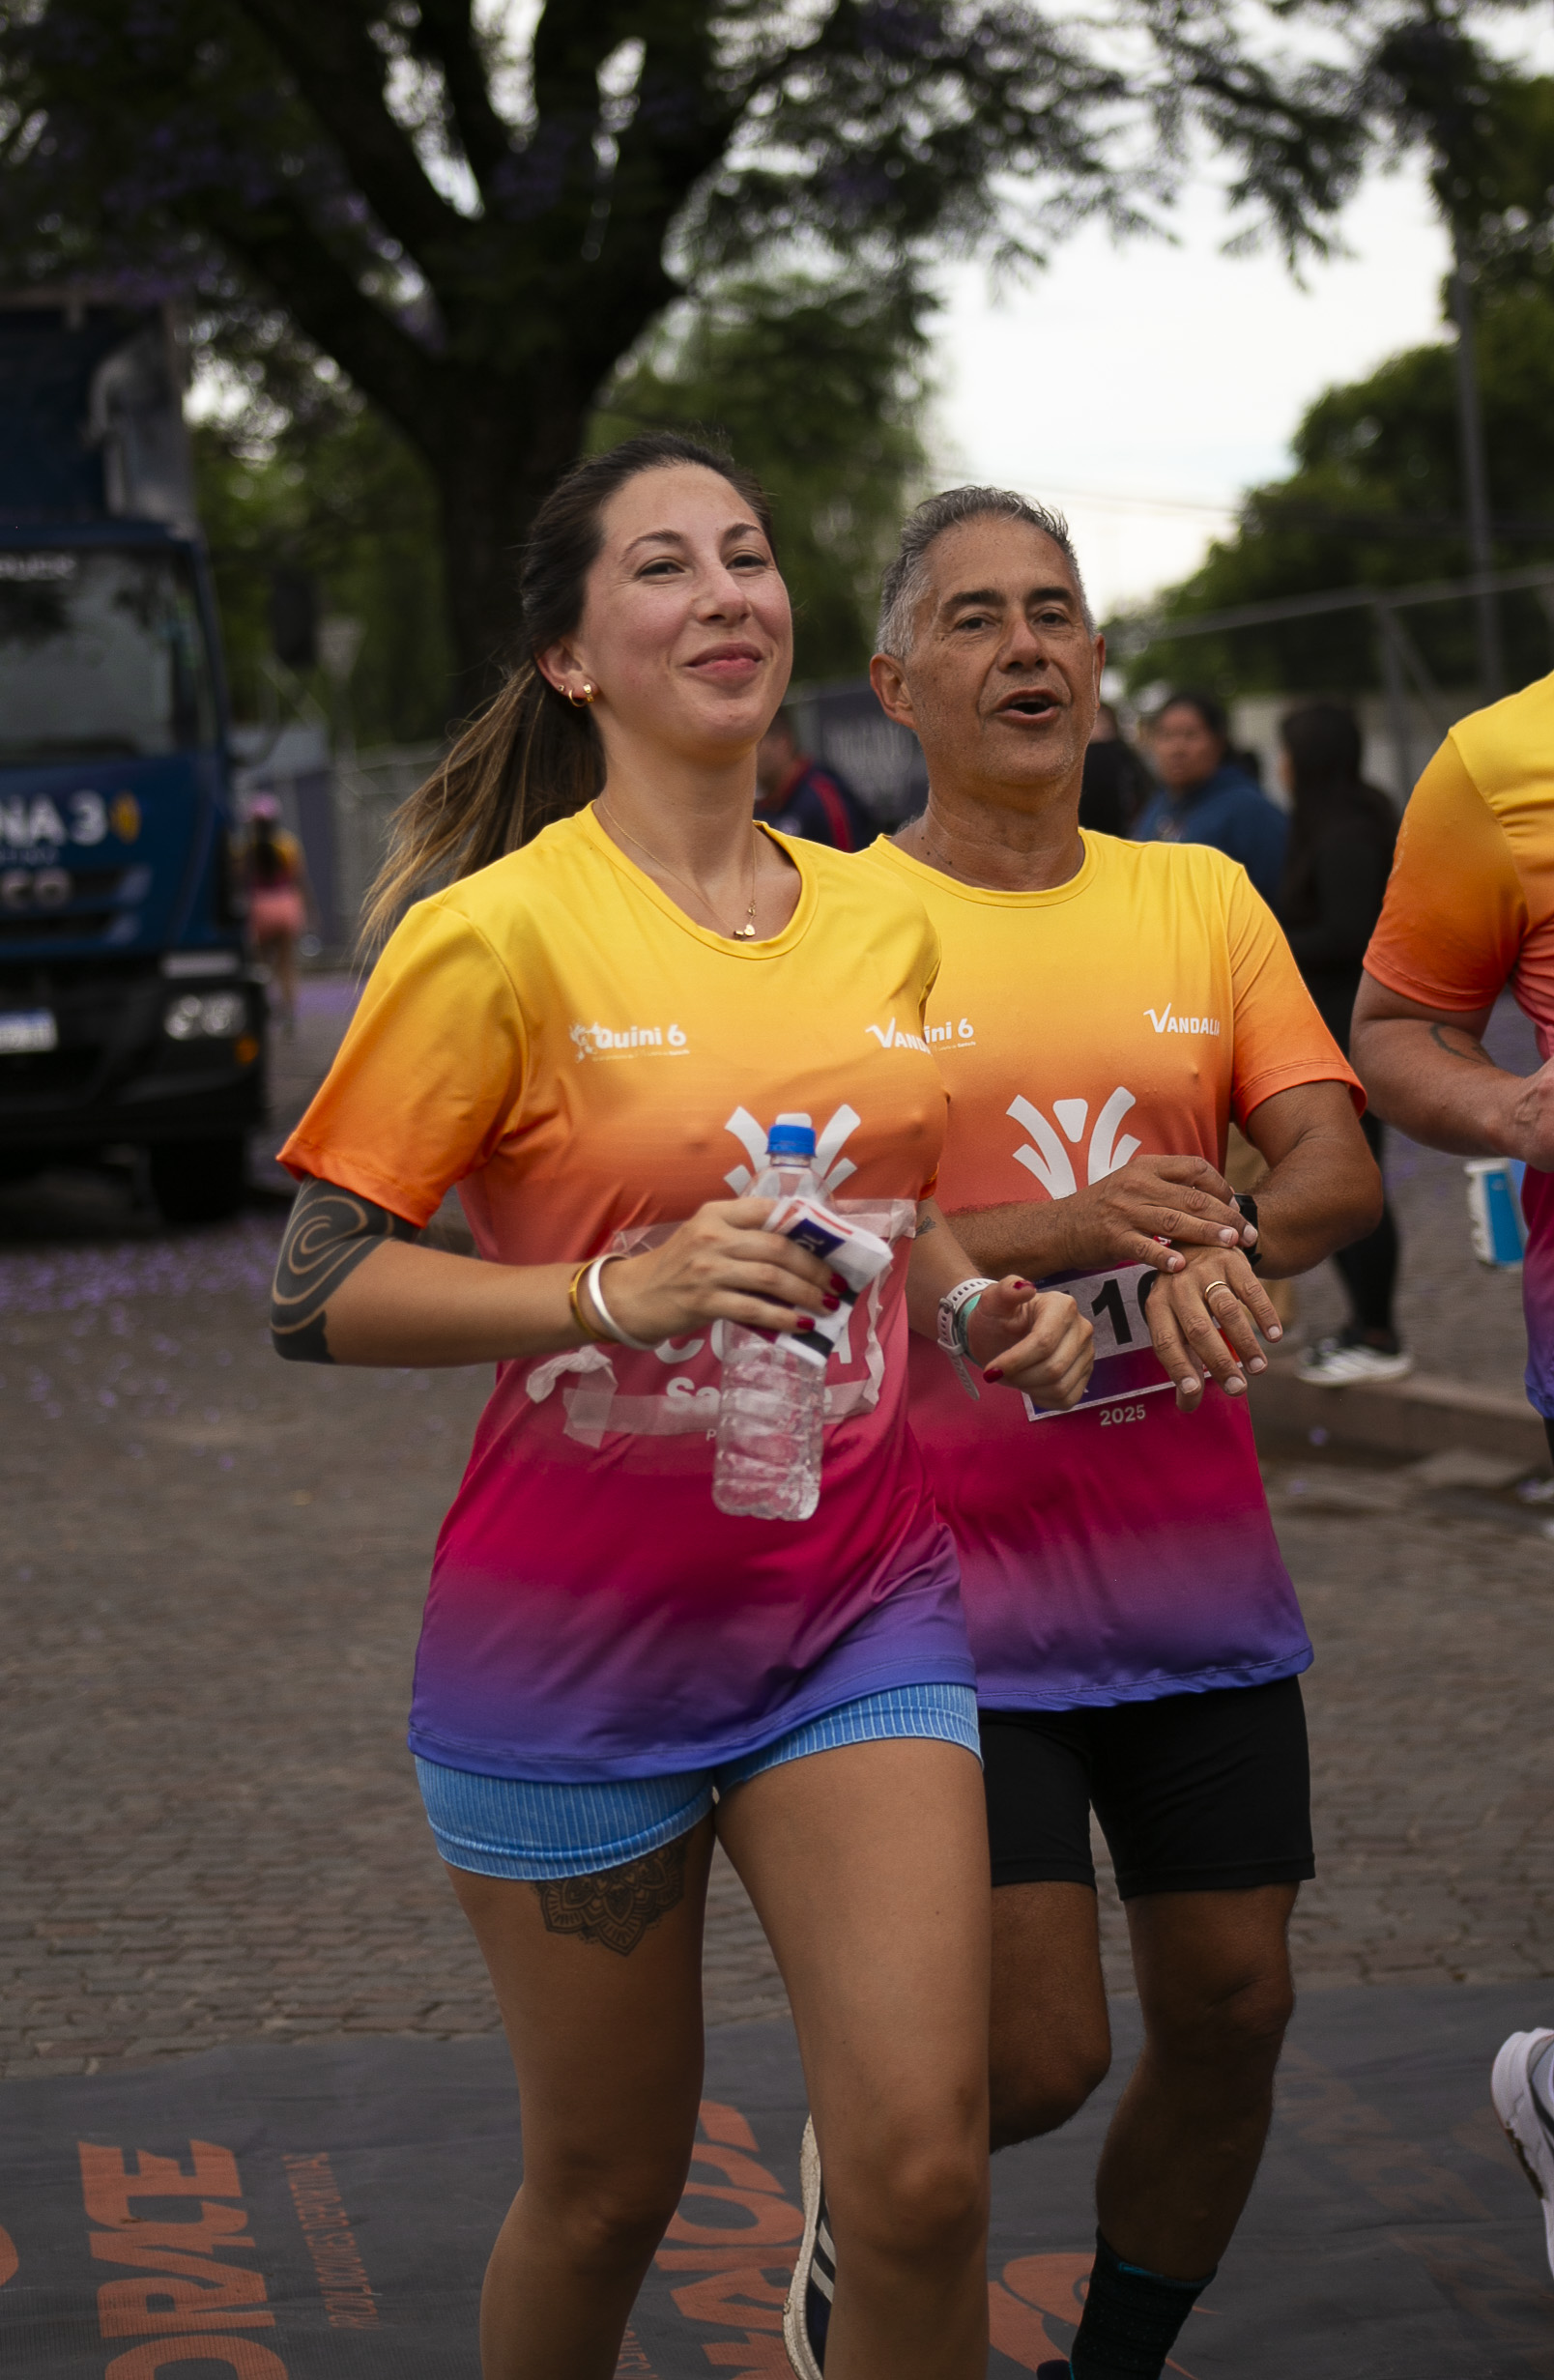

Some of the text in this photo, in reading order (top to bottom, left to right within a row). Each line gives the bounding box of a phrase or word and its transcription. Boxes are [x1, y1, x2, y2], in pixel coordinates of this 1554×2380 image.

[0, 789, 108, 847] NA 3
[0, 869, 72, 909] CO
[595, 1023, 687, 1049] Quini 6
[865, 1017, 933, 1056] VAND
[924, 1018, 974, 1044] ini 6
[1099, 1403, 1146, 1427] 2025
[77, 2138, 289, 2380] ORACE
